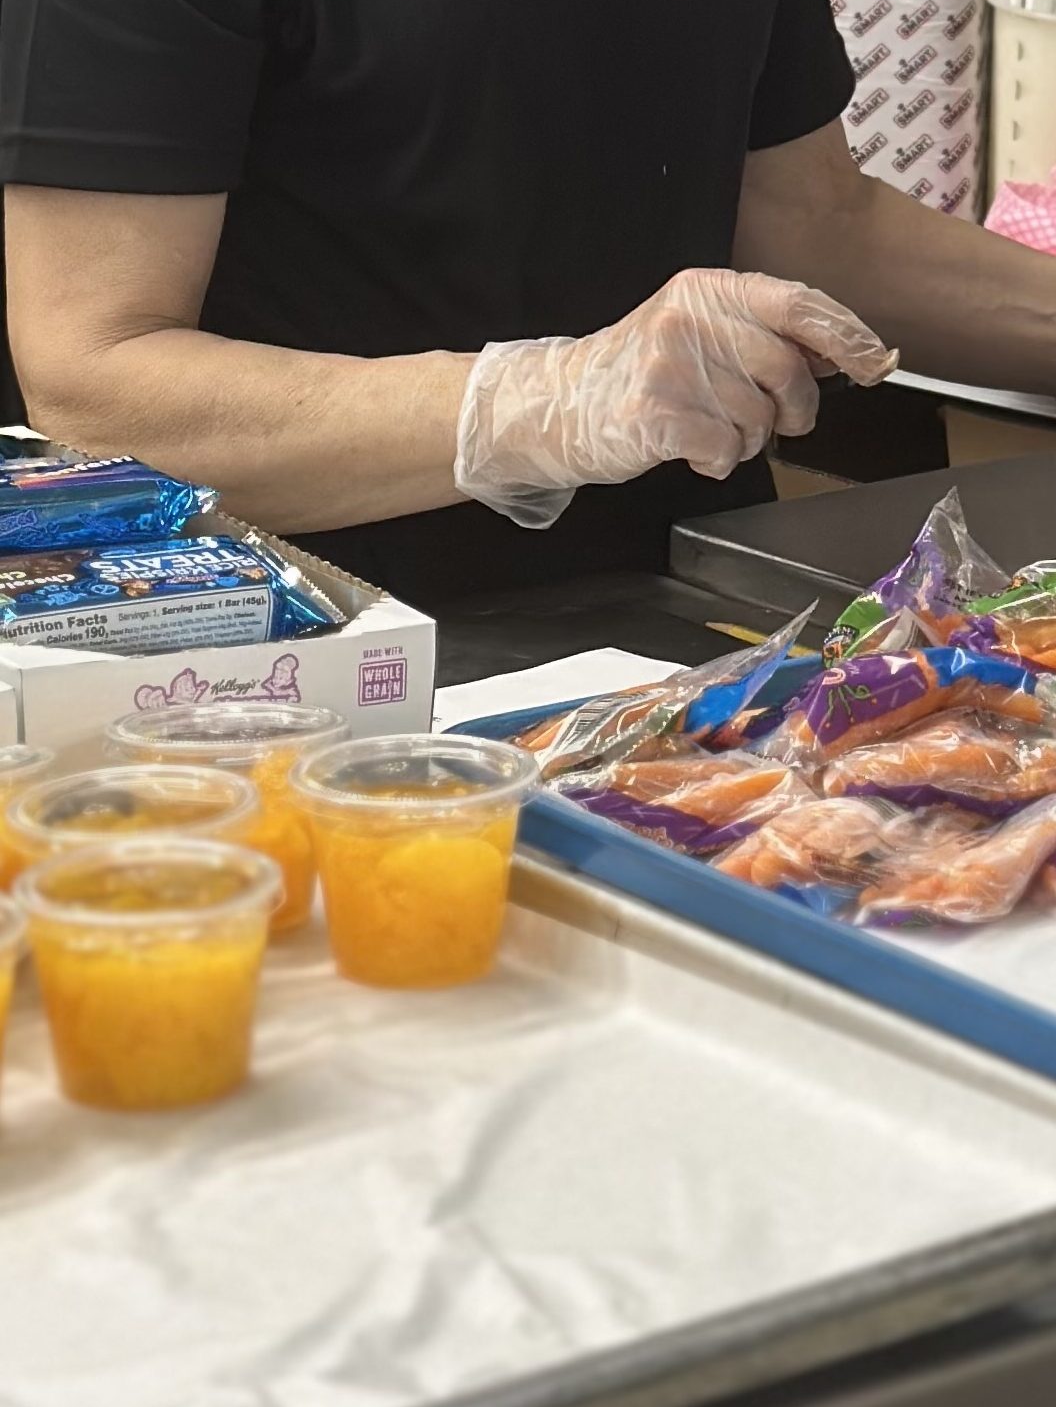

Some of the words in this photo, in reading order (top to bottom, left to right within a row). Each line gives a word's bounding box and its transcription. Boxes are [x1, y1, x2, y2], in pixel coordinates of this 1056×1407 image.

[854, 1, 889, 35] SMART
[899, 2, 936, 38] SMART
[946, 3, 976, 40] SMART
[898, 48, 934, 83] SMART
[944, 48, 974, 84] SMART
[851, 92, 886, 125] SMART
[897, 93, 932, 126] SMART
[856, 136, 885, 164] MART
[896, 137, 931, 171] SMART
[90, 549, 245, 573] TREATS
[100, 565, 208, 583] KRISPIES
[211, 557, 258, 571] RICE
[66, 613, 108, 629] Facts
[161, 604, 193, 616] Serving
[195, 601, 215, 611] size:
[224, 598, 240, 607] Bar
[46, 632, 83, 644] Calories
[210, 678, 257, 695] Kellogg's
[364, 665, 402, 683] WHOLE
[365, 680, 401, 699] GRAIN
